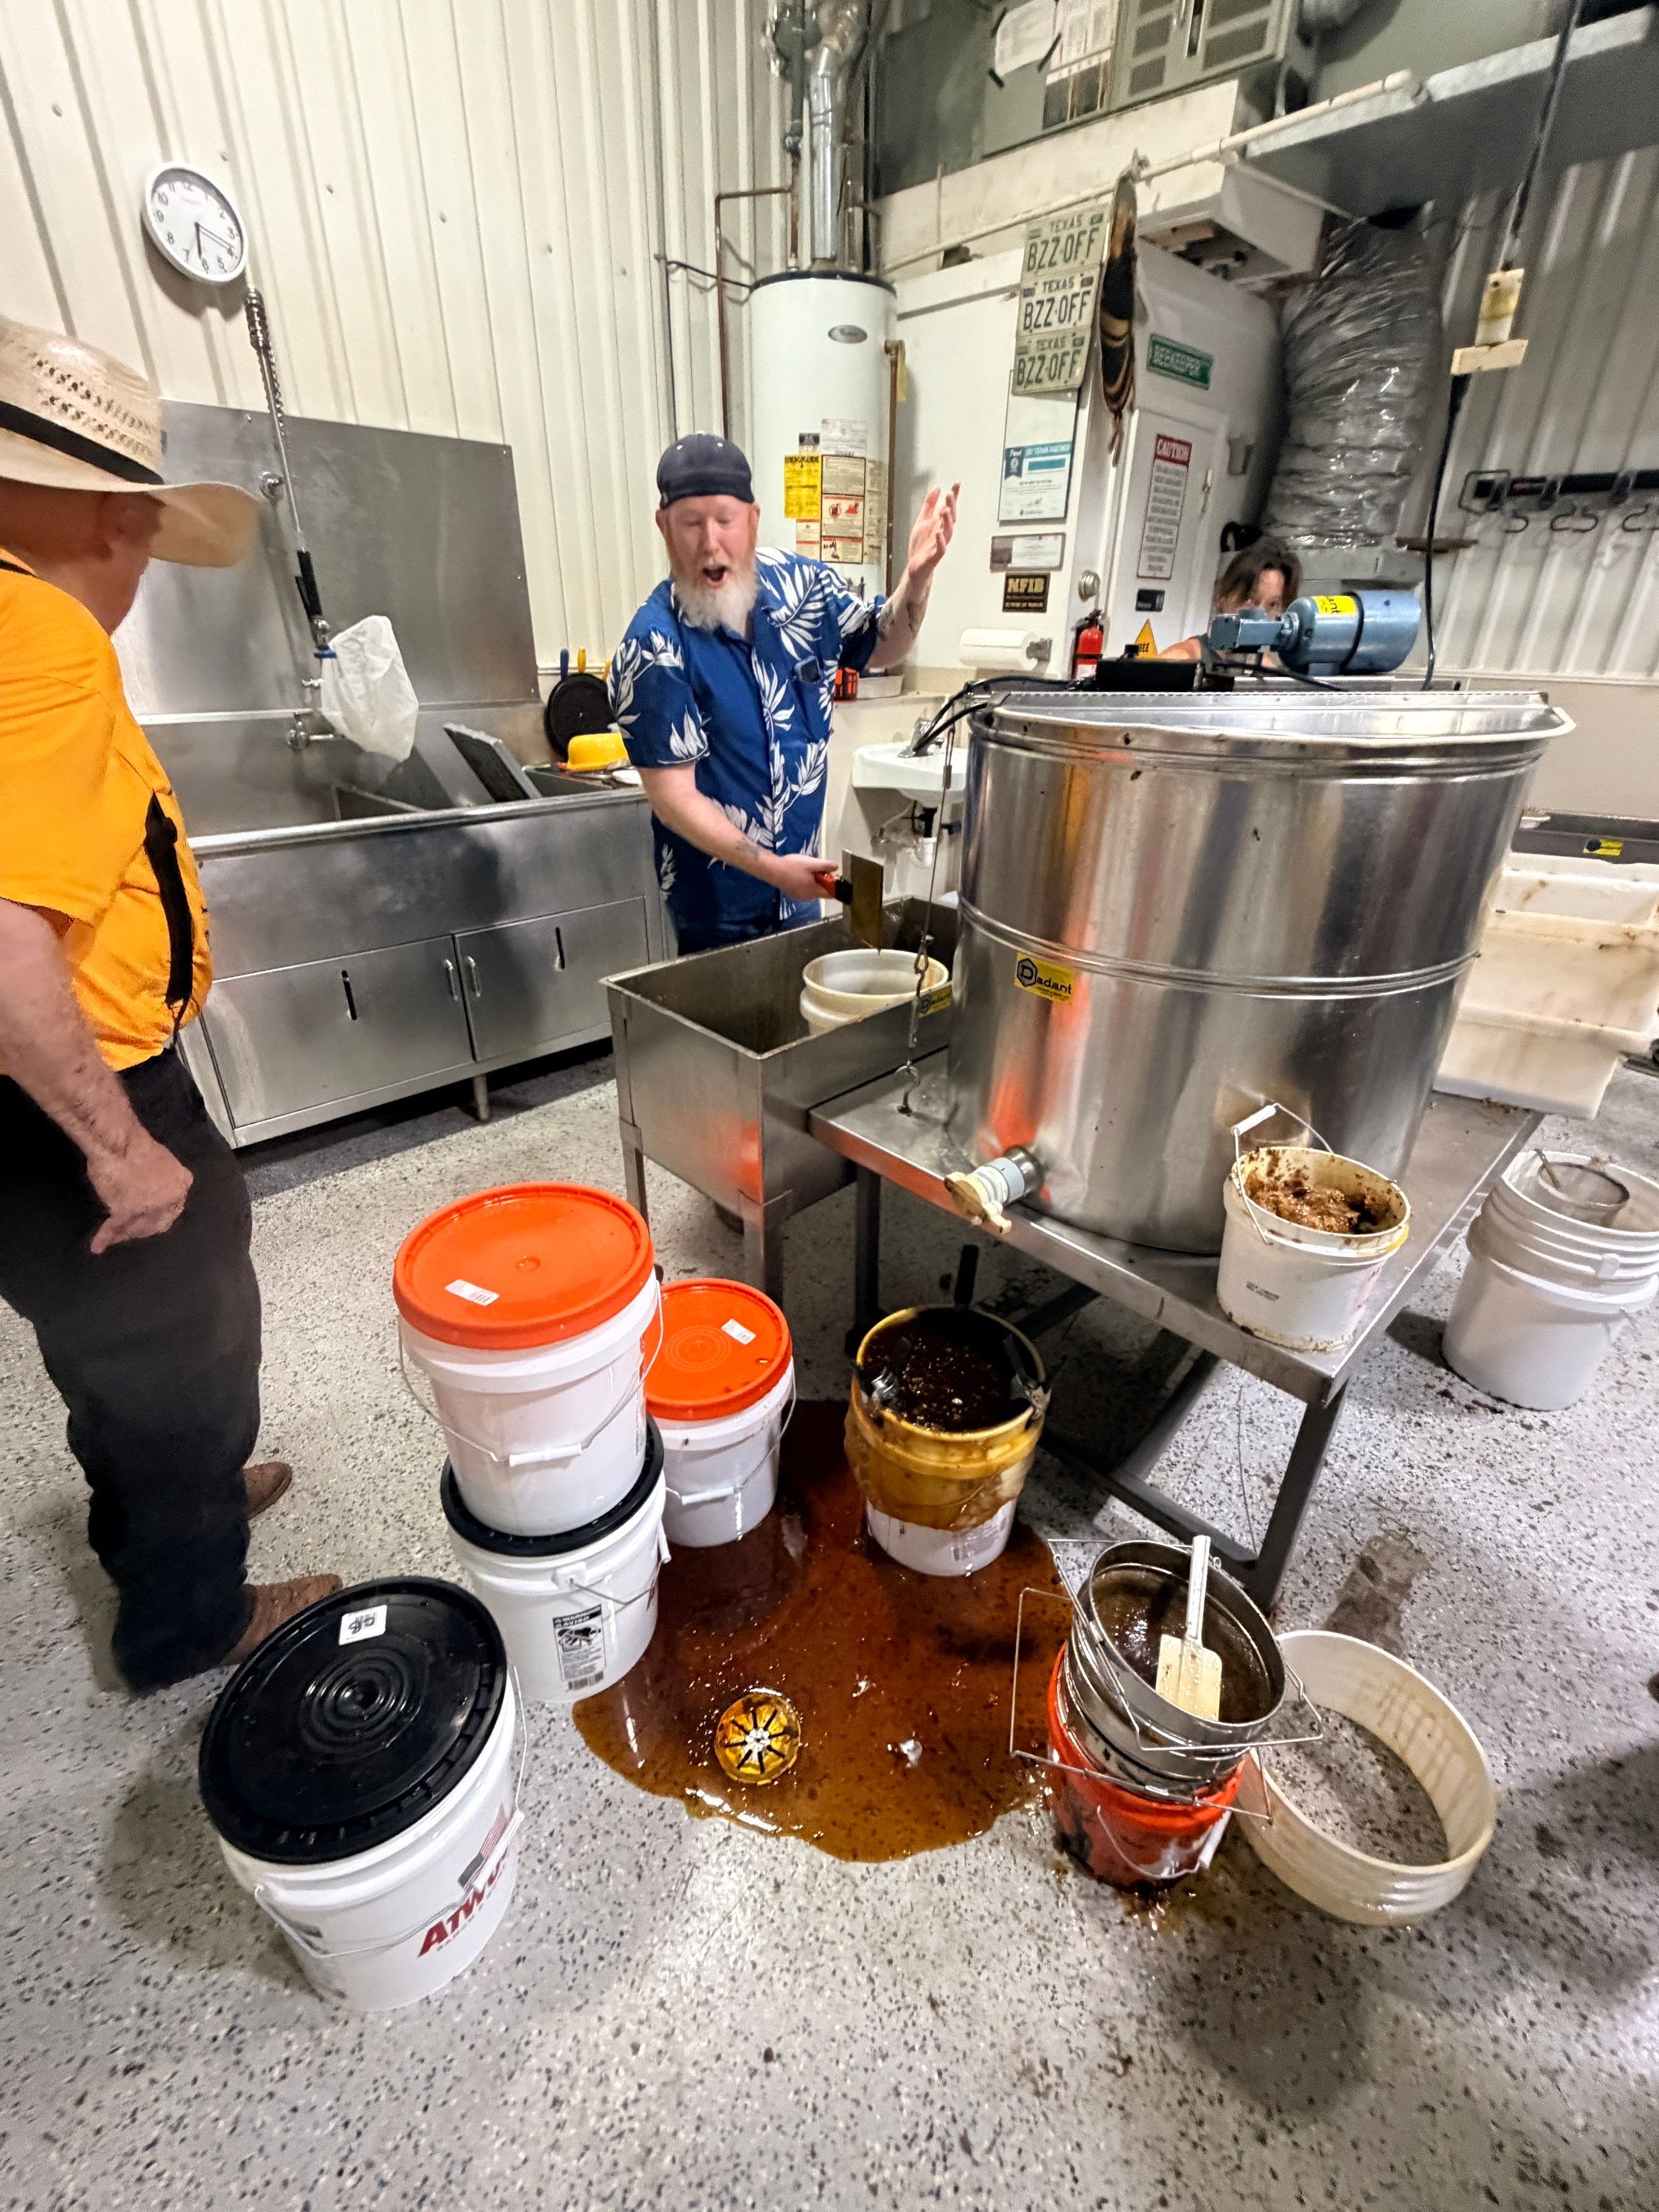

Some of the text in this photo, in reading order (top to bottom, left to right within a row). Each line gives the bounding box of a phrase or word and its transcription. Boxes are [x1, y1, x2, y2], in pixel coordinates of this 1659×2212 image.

[157, 192, 169, 206] 10
[156, 210, 165, 223] 9
[1050, 214, 1083, 233] TEXAS
[167, 232, 174, 245] 8
[227, 227, 235, 240] 3
[1043, 277, 1075, 293] TEXAS
[1036, 336, 1067, 351] TEXAS
[563, 1615, 590, 1628] AVISO
